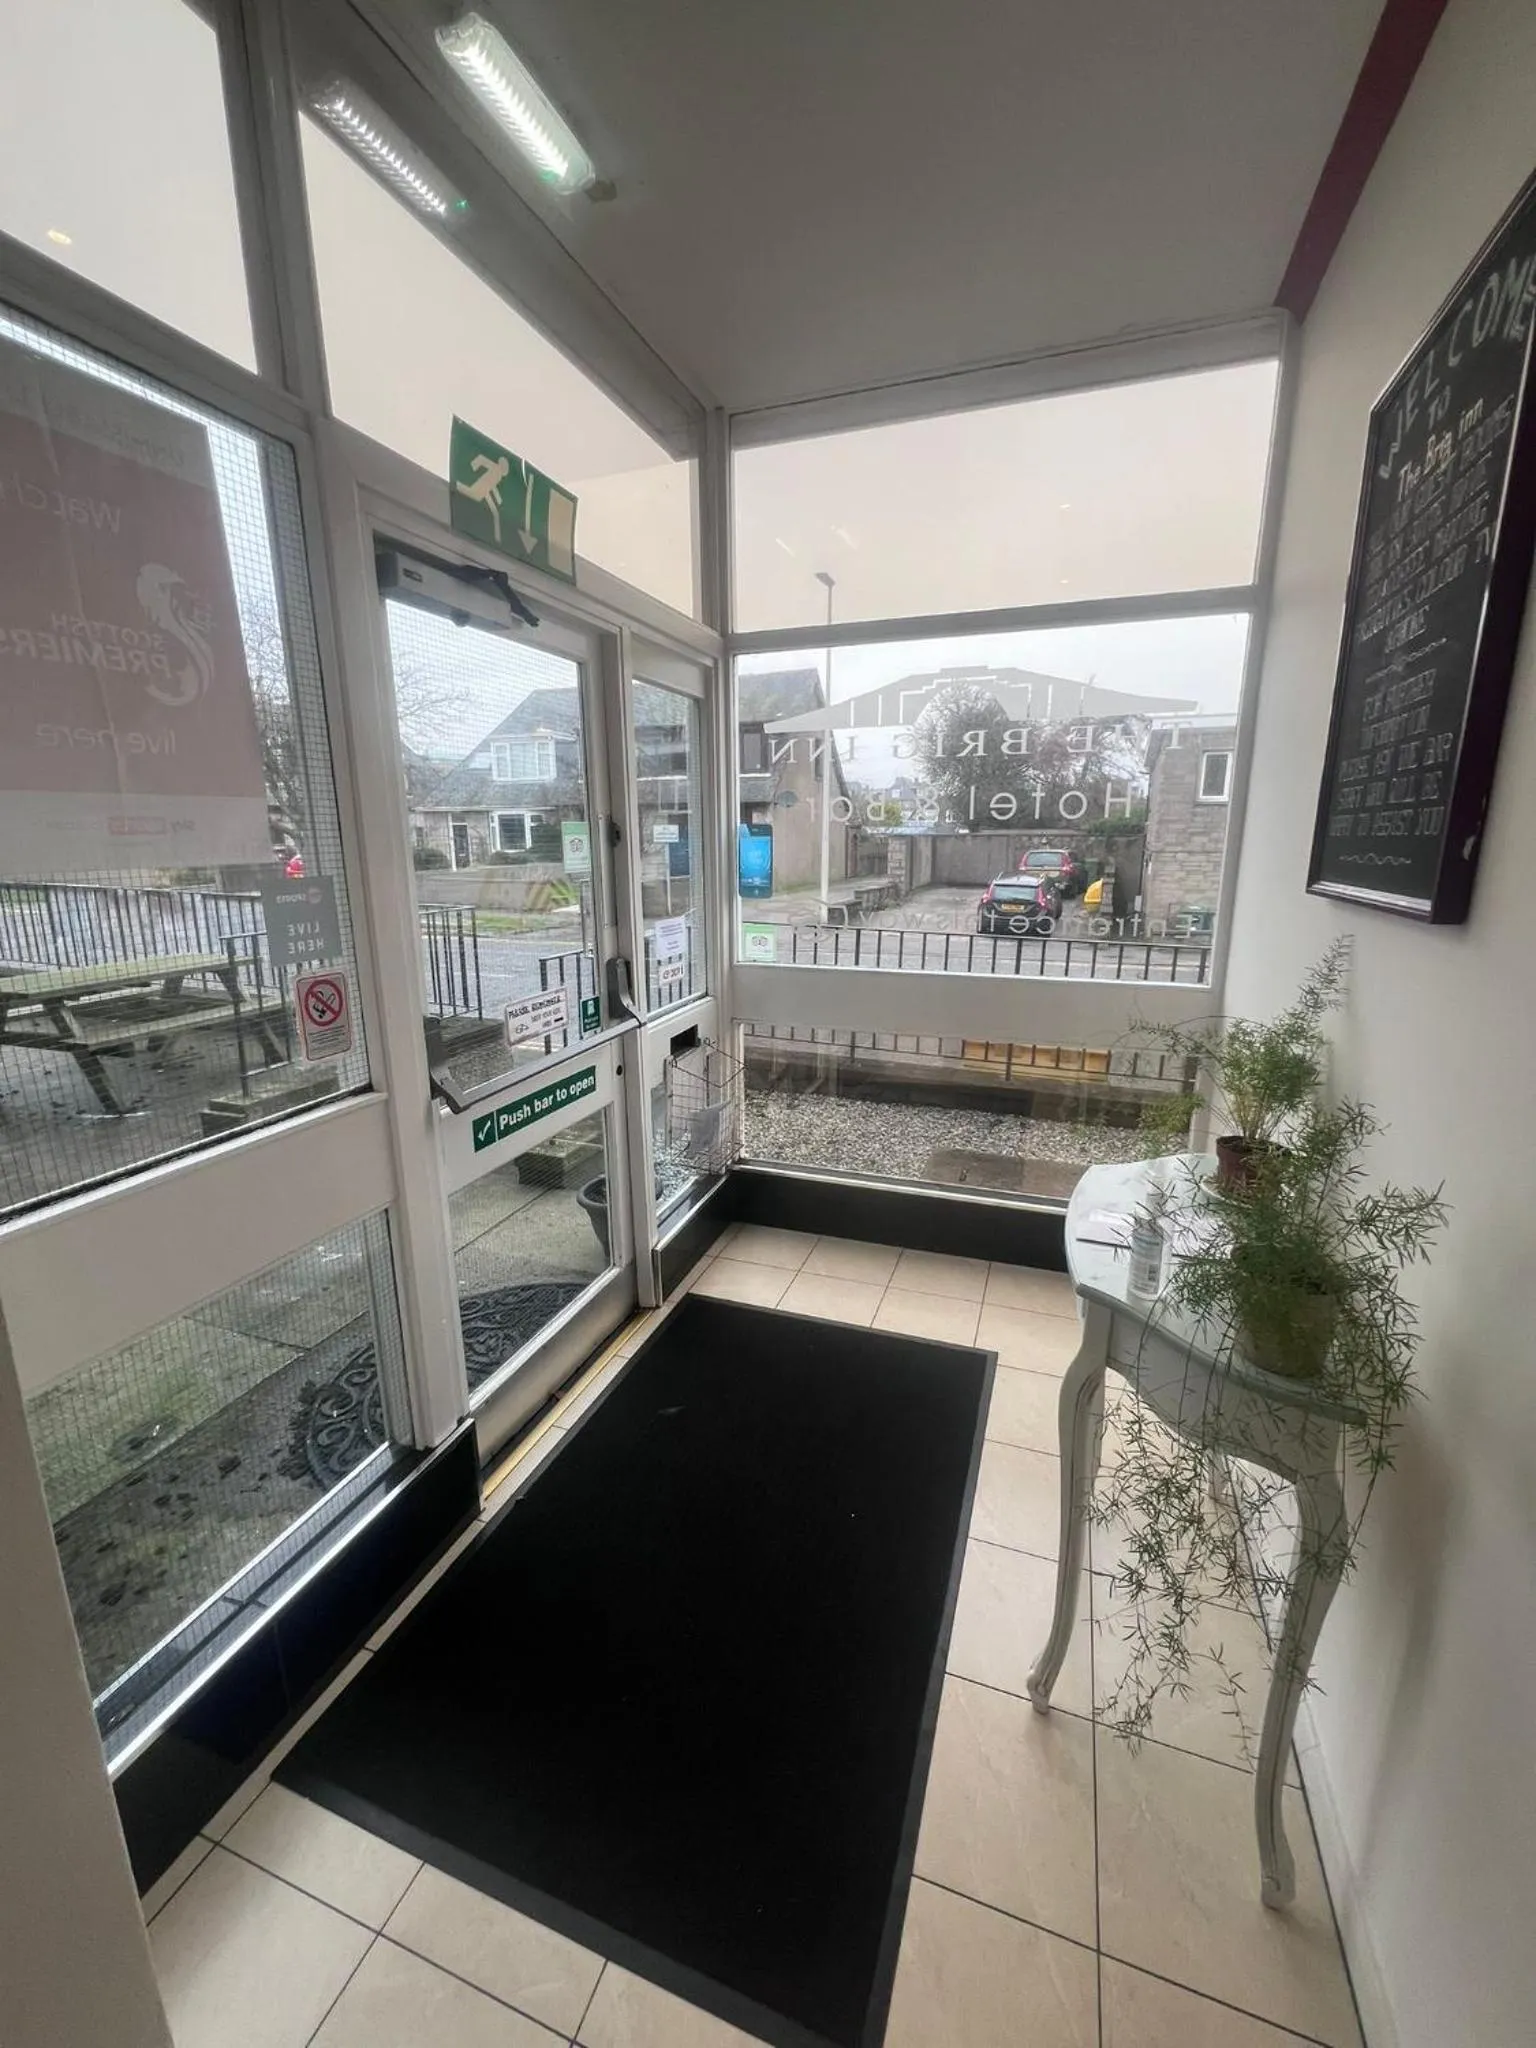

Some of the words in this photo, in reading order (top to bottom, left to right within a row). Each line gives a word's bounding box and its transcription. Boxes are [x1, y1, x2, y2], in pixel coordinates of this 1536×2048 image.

[1378, 252, 1536, 480] WELCOME
[1429, 385, 1450, 430] TO
[1399, 460, 1422, 501] The
[499, 1105, 532, 1131] Push
[534, 1094, 554, 1113] bar
[556, 1087, 567, 1102] to
[569, 1074, 595, 1098] open
